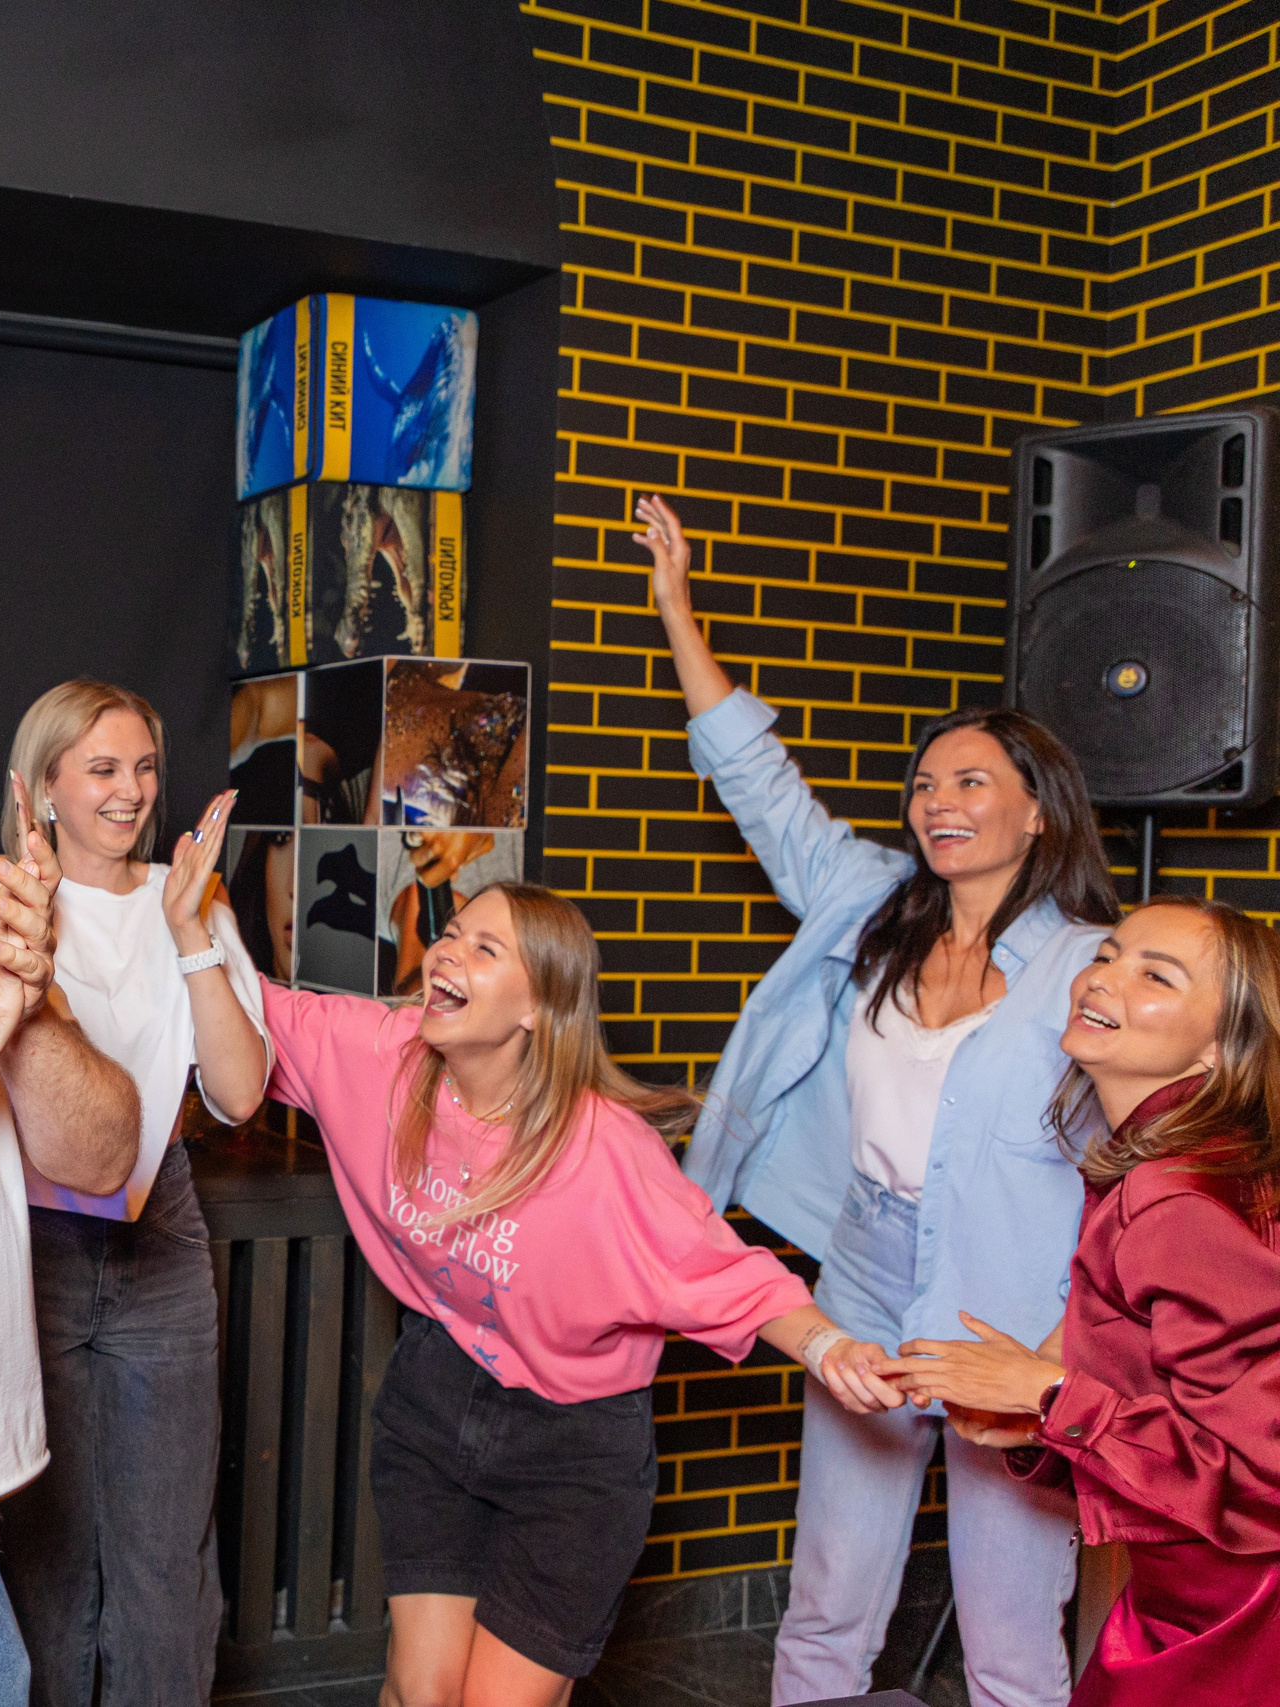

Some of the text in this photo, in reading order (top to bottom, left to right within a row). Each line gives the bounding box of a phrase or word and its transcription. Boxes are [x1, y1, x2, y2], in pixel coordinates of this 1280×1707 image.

[330, 341, 350, 431] СИНИЙ КИТ
[439, 537, 456, 621] КРОКОДИЛ
[447, 1225, 519, 1284] Flow
